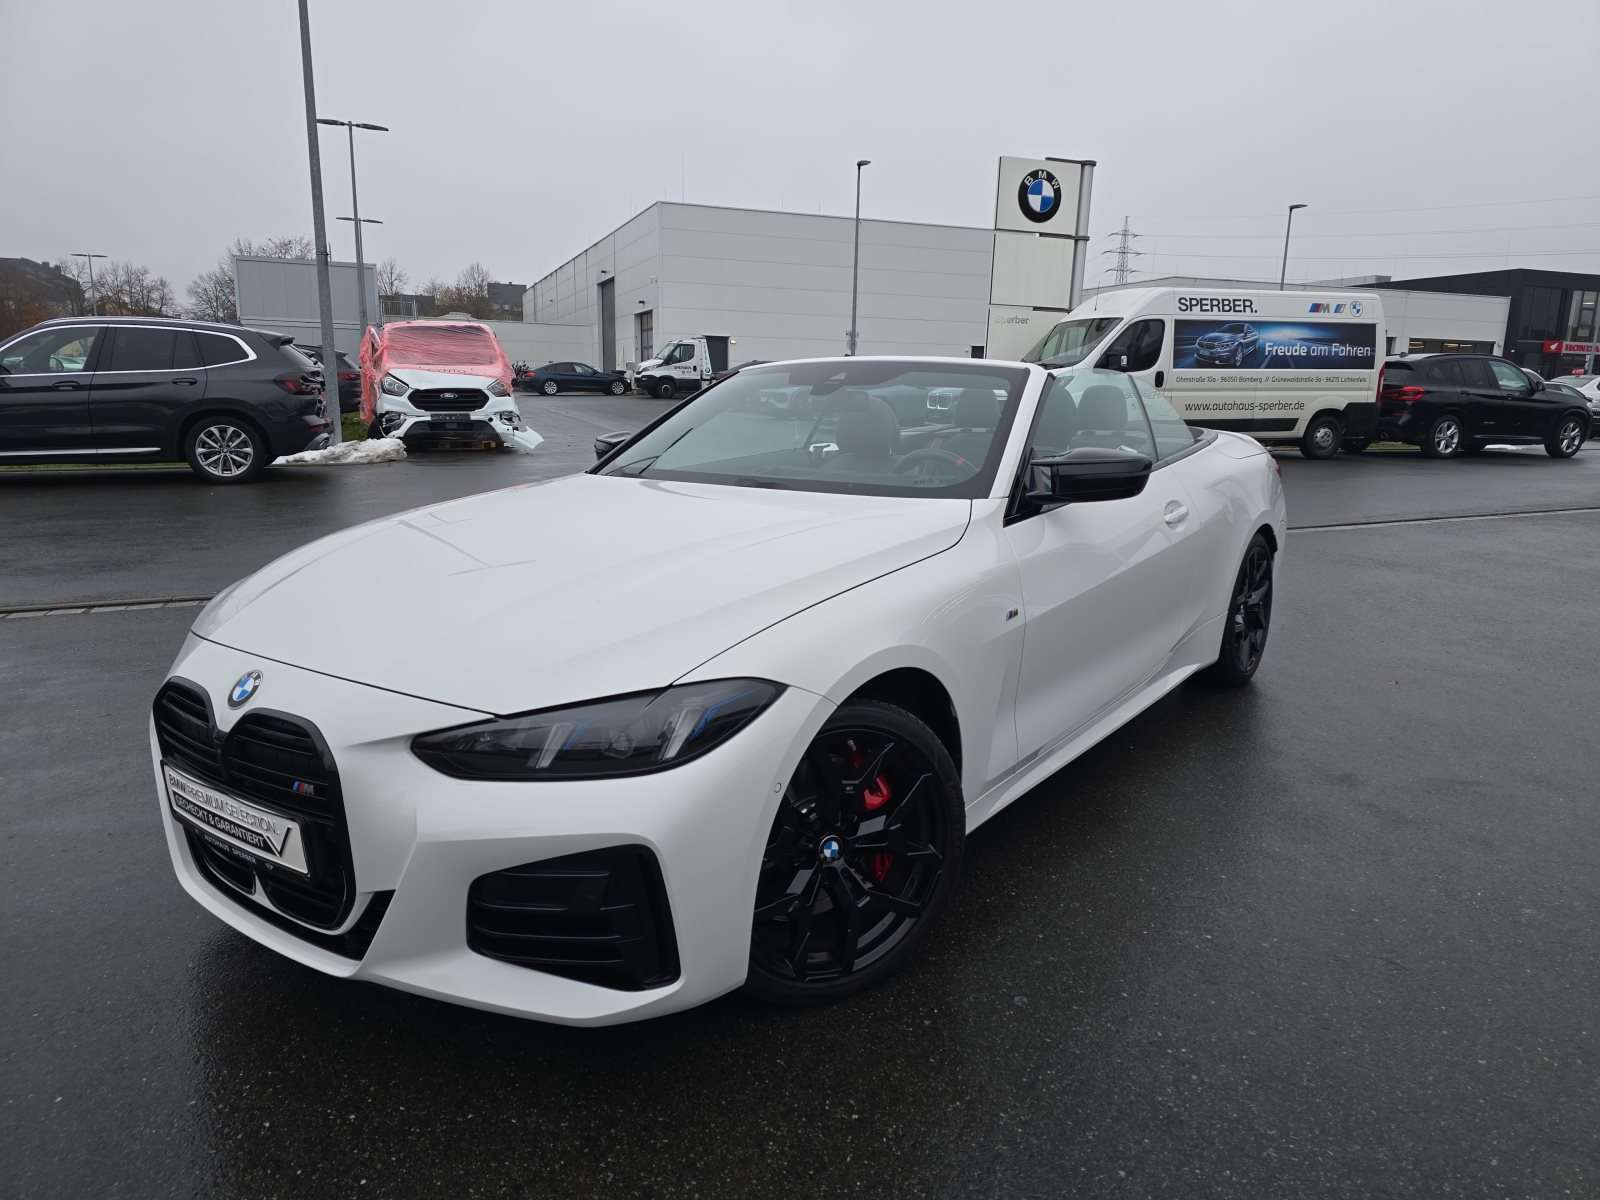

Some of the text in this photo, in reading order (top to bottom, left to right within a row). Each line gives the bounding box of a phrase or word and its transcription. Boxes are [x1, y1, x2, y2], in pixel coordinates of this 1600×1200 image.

[1025, 170, 1059, 189] BMW
[1178, 297, 1258, 313] SPERBER.
[1265, 343, 1371, 357] Freude am Fahren
[1184, 400, 1305, 412] www.autohaus-sperber.de
[168, 774, 187, 793] BMW
[187, 785, 225, 812] PREMIUM
[175, 794, 208, 823] GECHECKT
[214, 816, 264, 847] GARANTIERT
